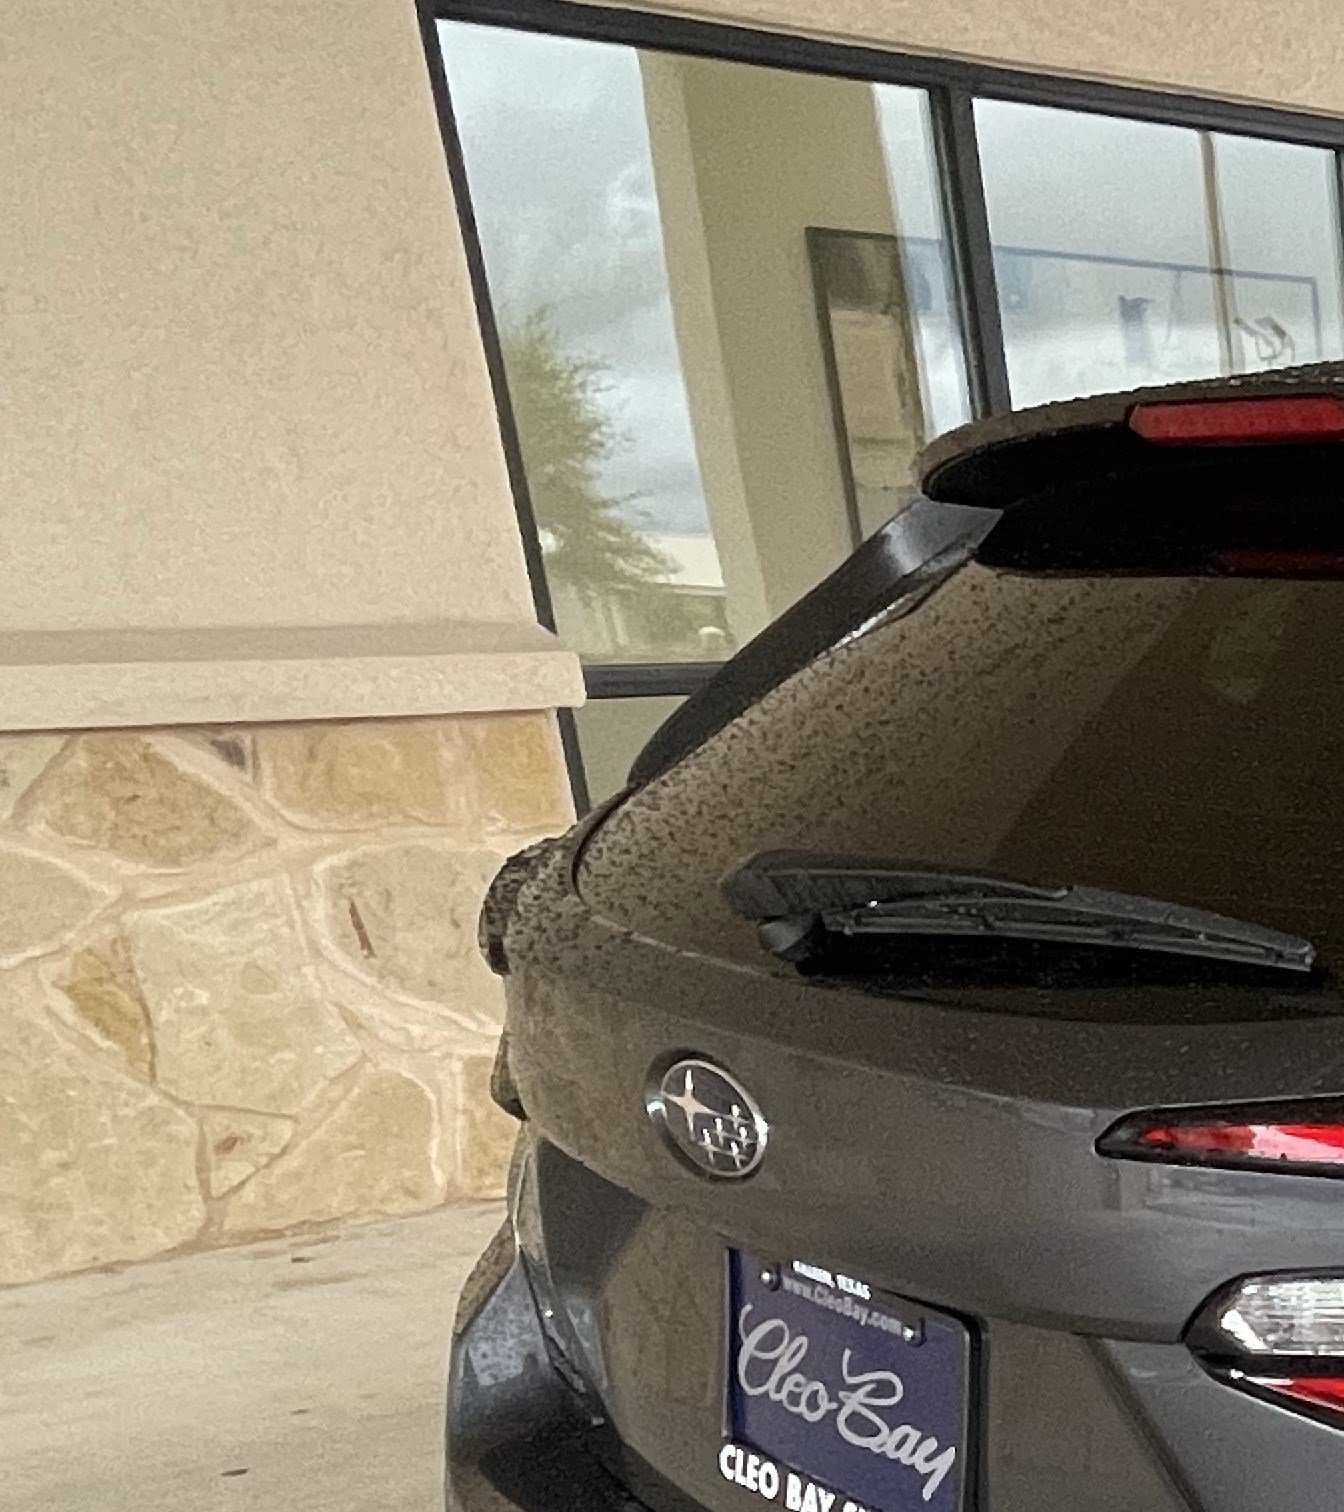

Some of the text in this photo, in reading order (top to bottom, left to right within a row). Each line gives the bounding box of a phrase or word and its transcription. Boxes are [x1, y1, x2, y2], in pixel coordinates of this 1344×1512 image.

[738, 1304, 956, 1501] Cleo Bay
[719, 1444, 780, 1499] CLEO
